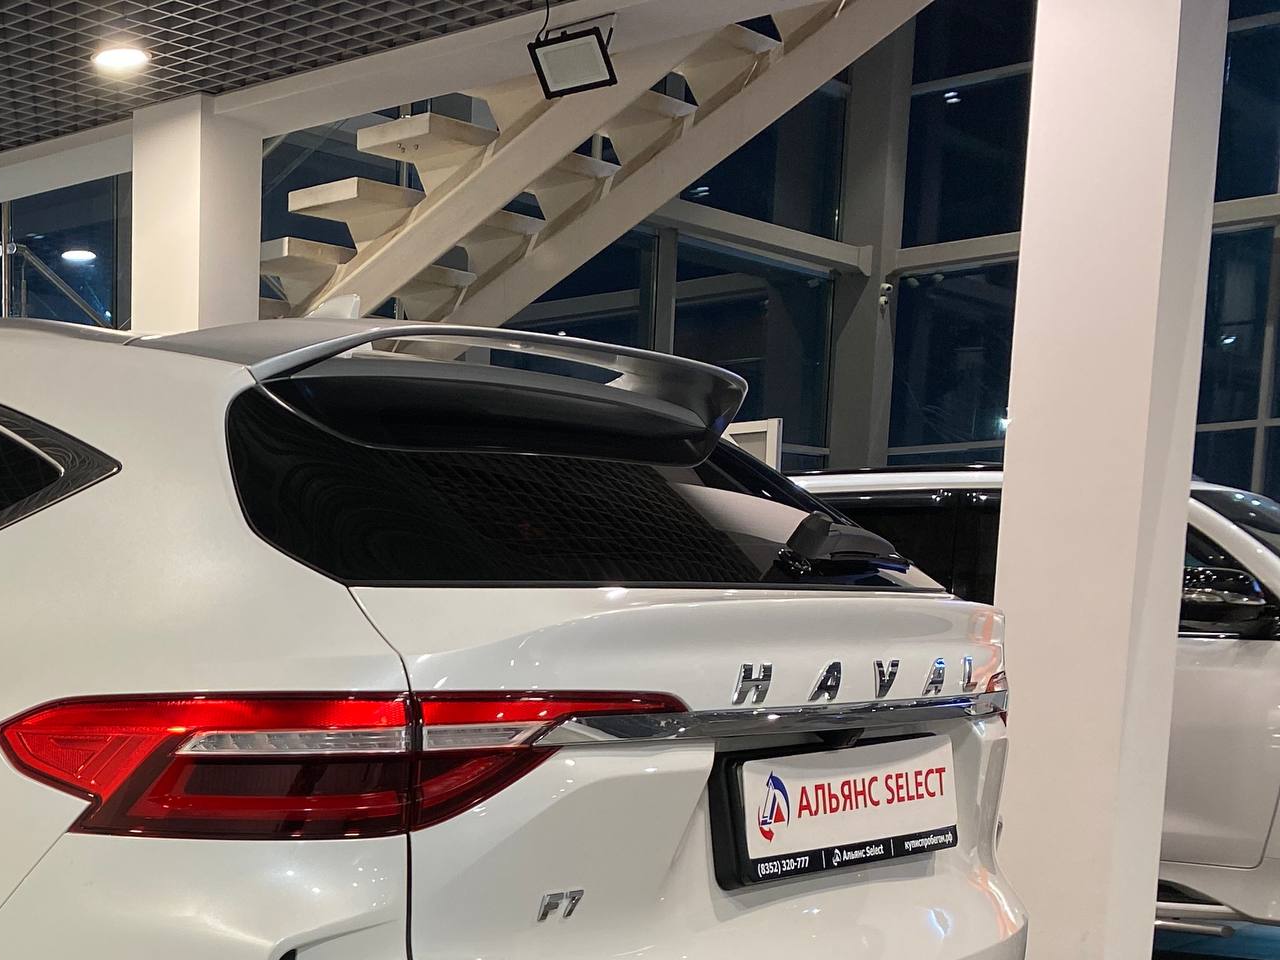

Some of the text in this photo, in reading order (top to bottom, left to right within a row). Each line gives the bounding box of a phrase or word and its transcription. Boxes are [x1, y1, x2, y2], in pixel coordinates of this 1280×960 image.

[732, 656, 977, 704] HAVAL
[797, 767, 946, 818] АЛЬЯНС SELECT
[757, 855, 809, 877] (8352) 320-777
[842, 844, 884, 861] Альянс Select
[537, 889, 584, 922] F7
